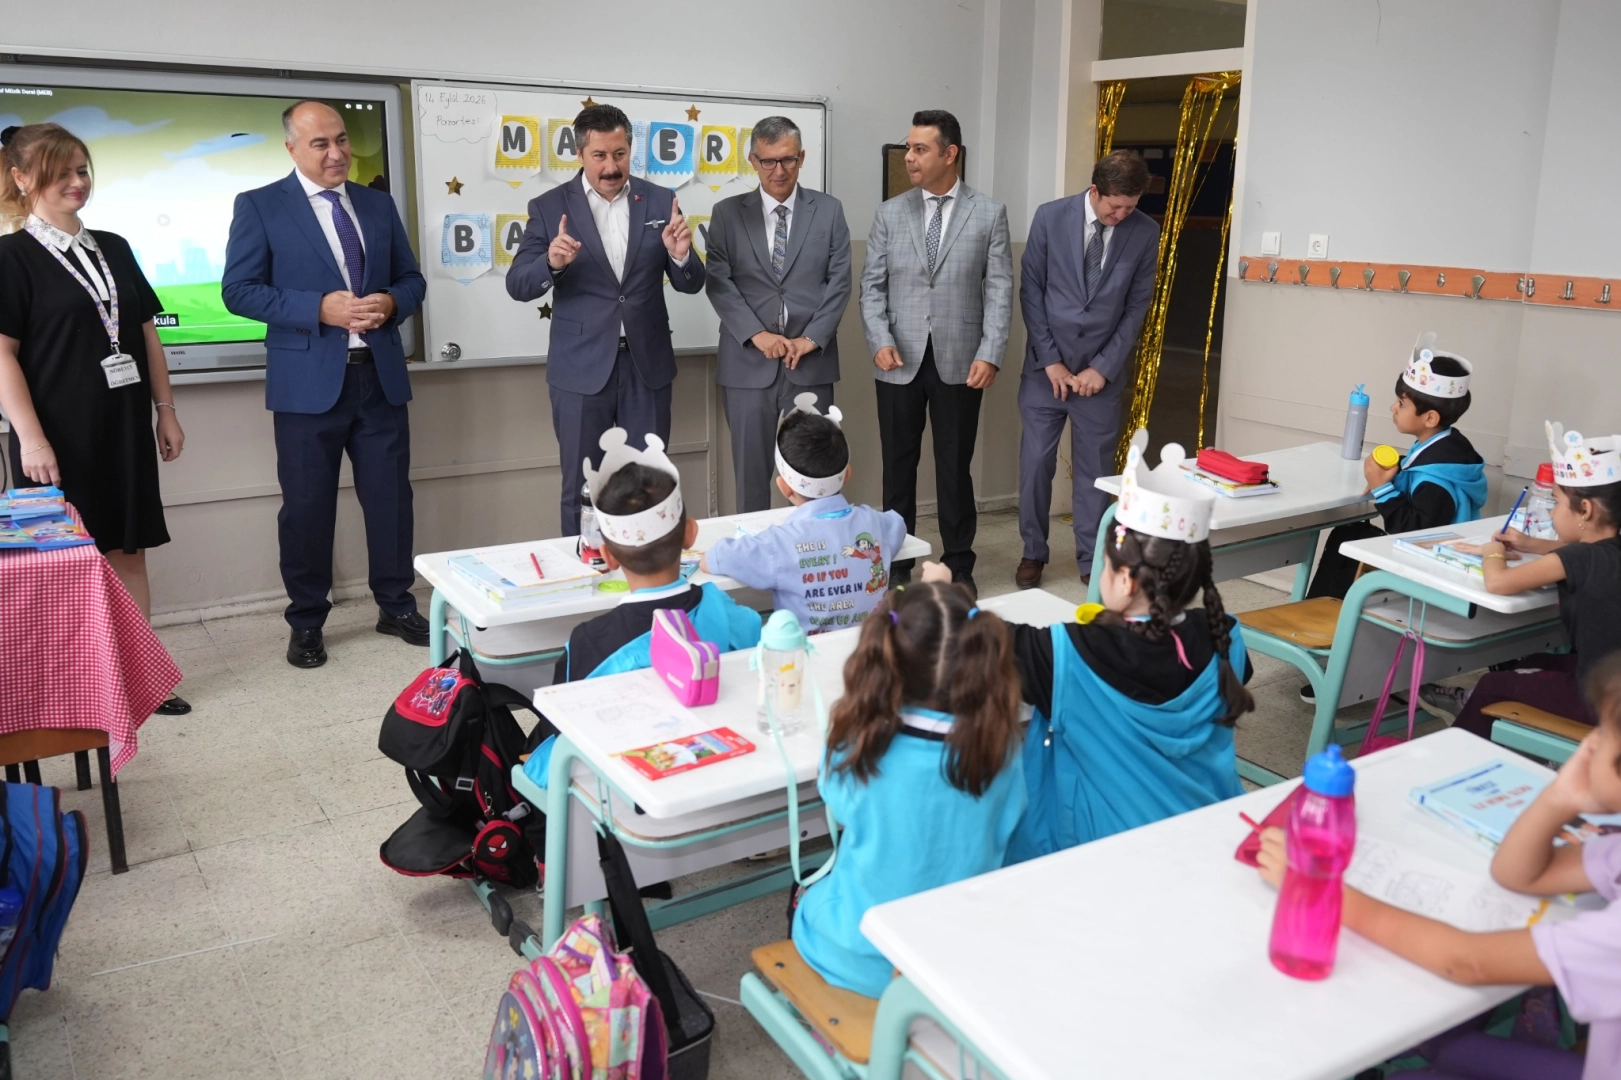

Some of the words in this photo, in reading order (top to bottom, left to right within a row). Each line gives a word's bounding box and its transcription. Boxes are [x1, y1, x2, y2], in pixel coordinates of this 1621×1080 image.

[440, 92, 459, 109] Eylül
[463, 93, 486, 104] 2026
[436, 115, 480, 126] Pazartesi
[796, 543, 815, 553] THE
[818, 540, 827, 550] IS
[800, 555, 830, 568] EVERY
[803, 573, 815, 583] SO
[817, 571, 826, 582] IF
[829, 568, 848, 580] YOU
[805, 588, 825, 599] ARE
[828, 584, 852, 596] EVER
[854, 582, 863, 592] IN
[808, 603, 827, 611] THE
[829, 599, 855, 611] AREA
[837, 615, 850, 625] UP
